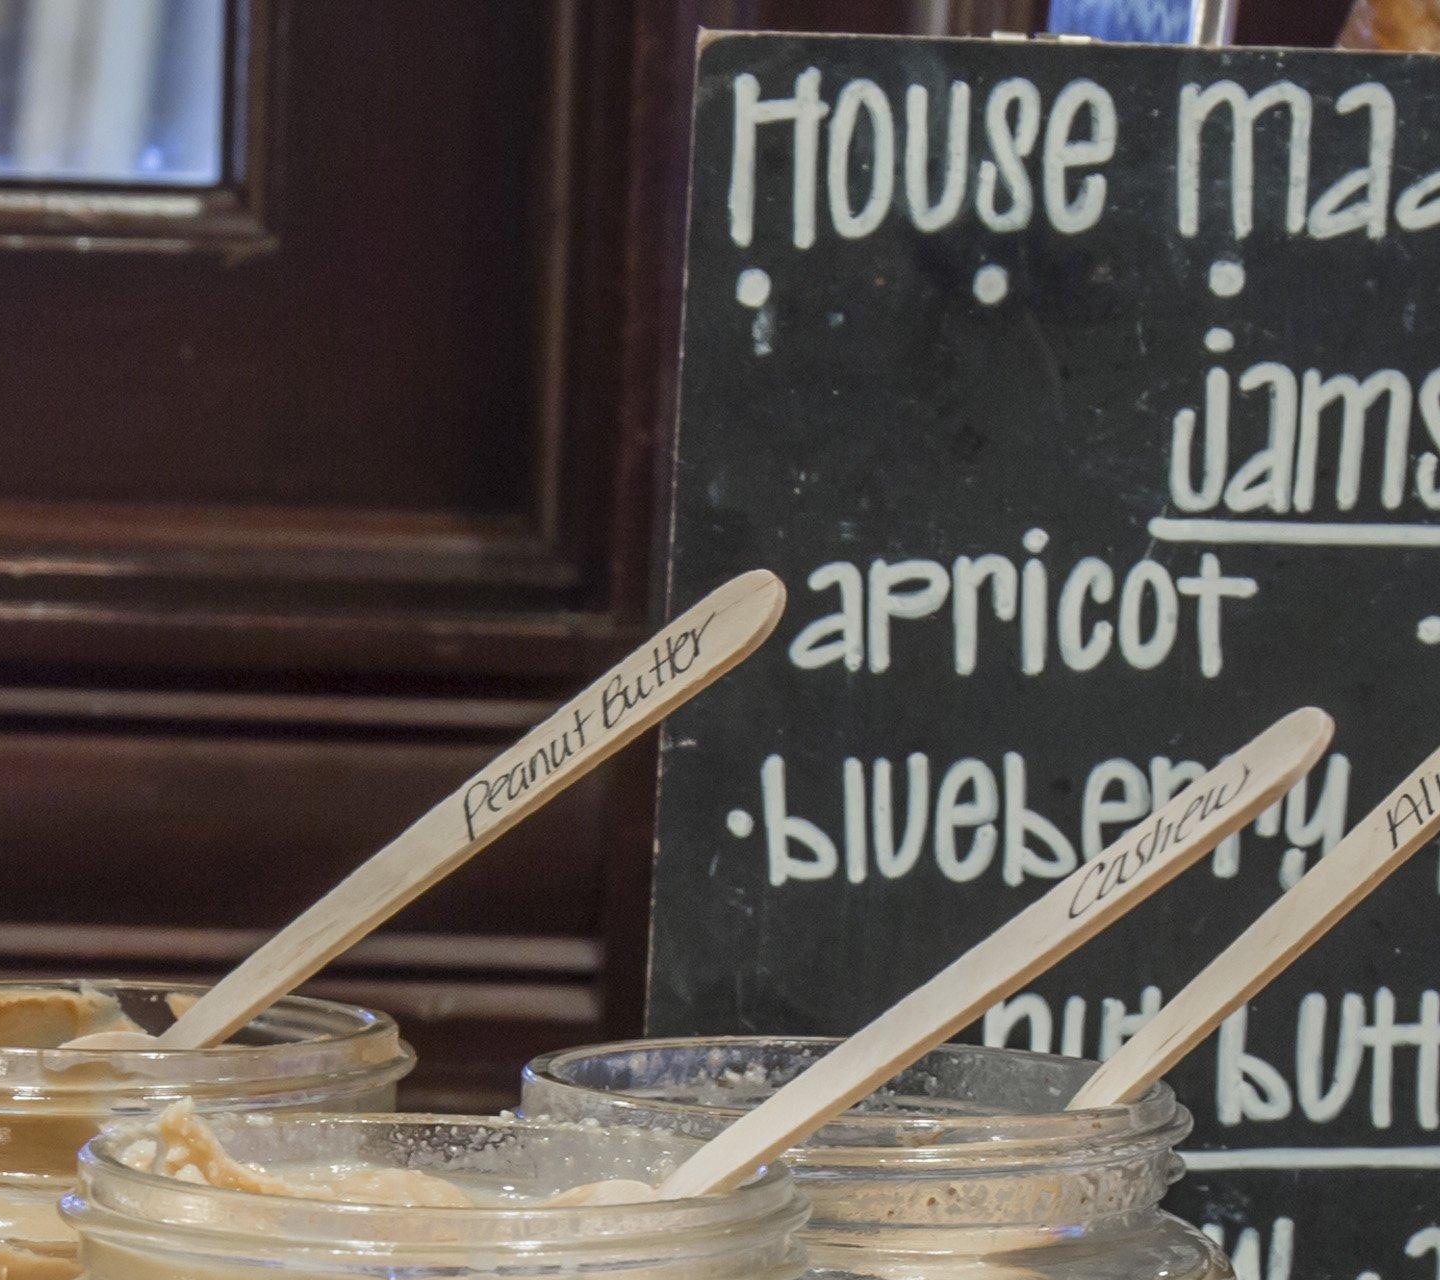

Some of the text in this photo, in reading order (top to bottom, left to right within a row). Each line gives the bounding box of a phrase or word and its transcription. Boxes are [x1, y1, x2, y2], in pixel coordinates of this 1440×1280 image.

[727, 67, 1117, 249] House
[787, 526, 1257, 679] apricot
[462, 611, 718, 842] Peanut Butter
[1069, 762, 1251, 920] Cashew
